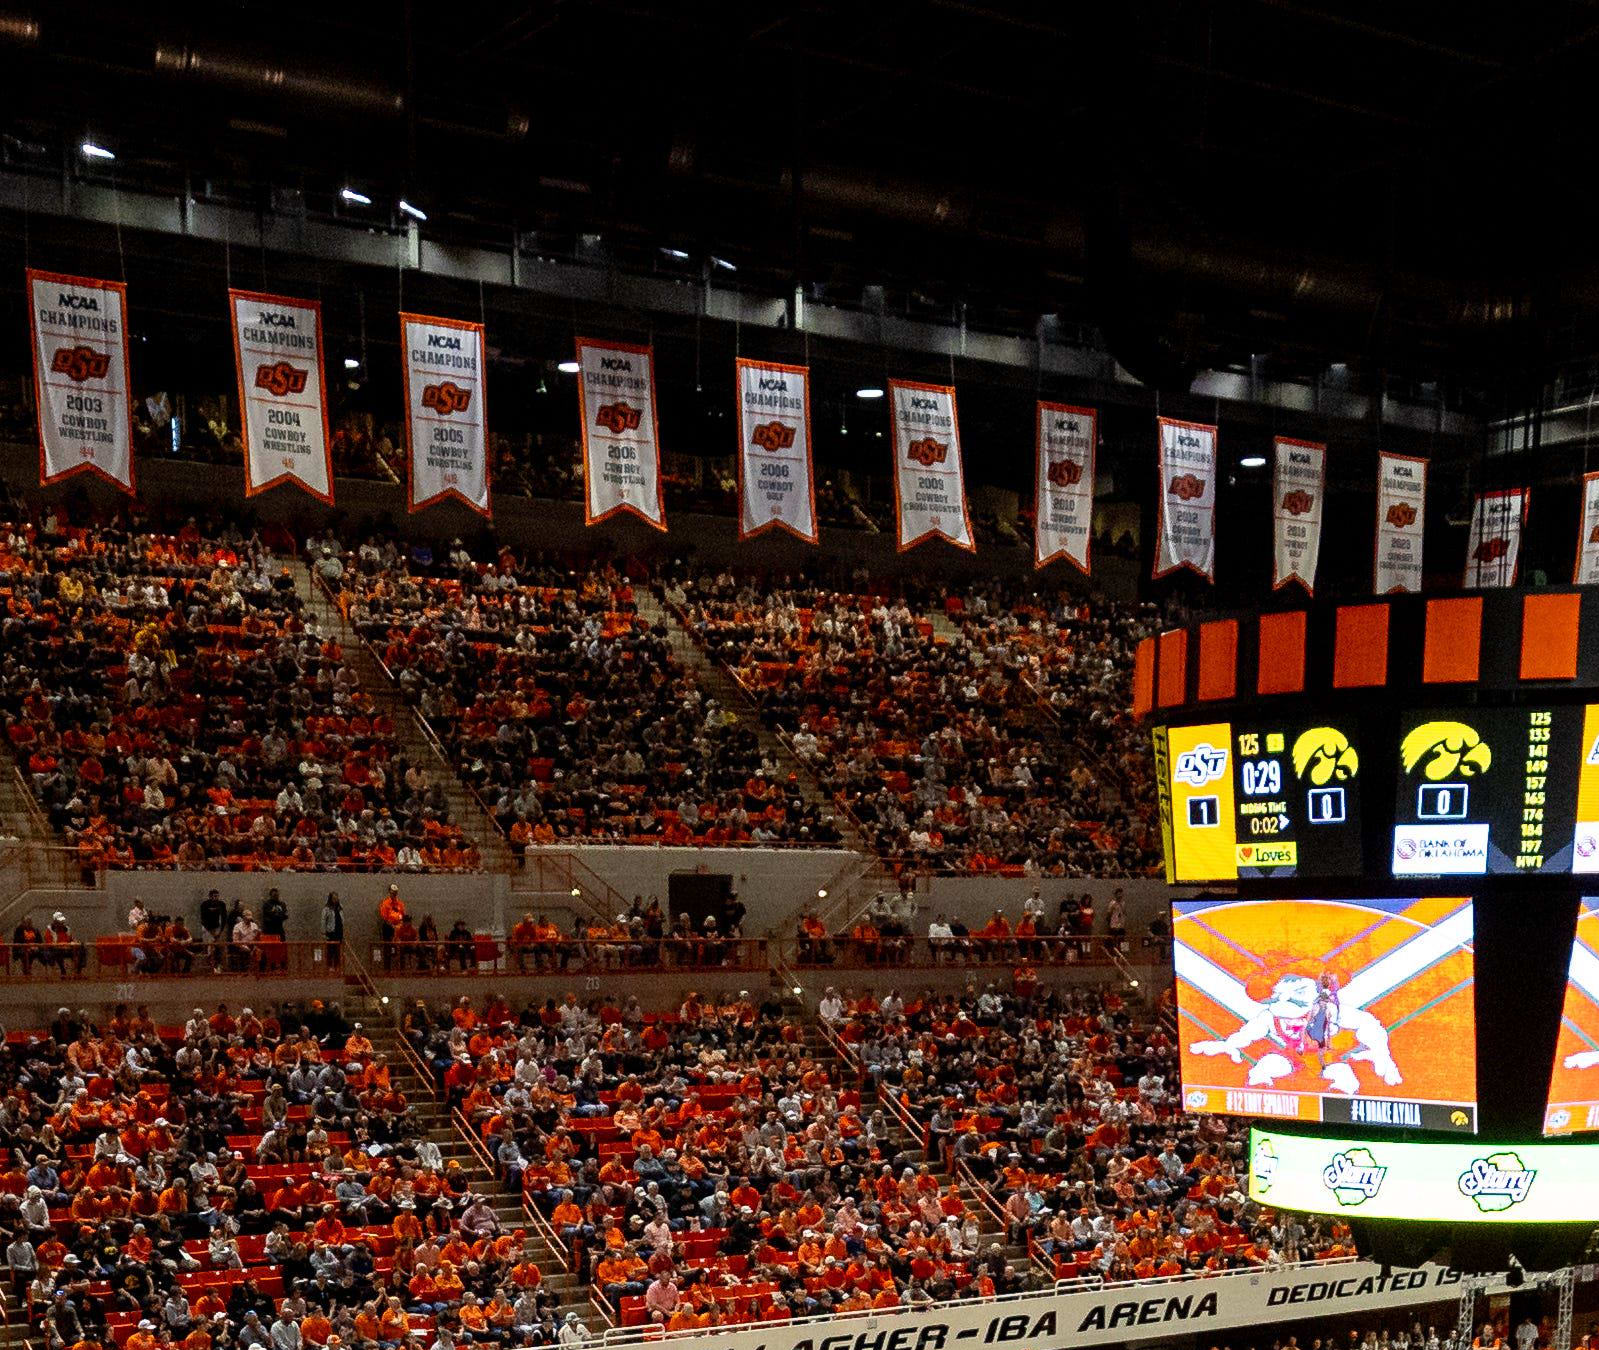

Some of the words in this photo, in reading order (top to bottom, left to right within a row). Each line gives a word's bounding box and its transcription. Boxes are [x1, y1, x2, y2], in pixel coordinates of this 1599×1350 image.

[58, 293, 99, 311] NCAA
[39, 309, 118, 334] CHAMPIONS
[258, 312, 295, 328] NCAA
[243, 327, 315, 350] CHAMPIONS
[428, 334, 461, 350] NCAA
[51, 345, 112, 383] OSU
[412, 350, 476, 370] CHAMPIONS
[601, 357, 632, 373] NCAA
[255, 361, 309, 397] OSU
[586, 372, 647, 391] CHAMPIONS
[758, 378, 788, 393] NCAA
[66, 395, 102, 412] 2003
[421, 381, 472, 416] OSU
[745, 392, 803, 410] CHAMPIONS
[911, 397, 939, 411] NCAA
[62, 414, 107, 431] COWBOY
[268, 409, 301, 426] 2004
[900, 409, 951, 427] CHAMPIONS
[59, 427, 114, 443] WRESTLING
[264, 427, 306, 443] COWBOY
[433, 427, 464, 444] 2005
[262, 440, 312, 455] WRESTLING
[429, 444, 467, 459] COWBOY
[608, 444, 636, 459] 2006
[1530, 712, 1551, 726] 125
[1529, 728, 1550, 741] 133
[1238, 733, 1259, 755] 125
[1529, 744, 1549, 758] 141
[1173, 743, 1229, 787] OSU
[1526, 760, 1548, 774] 149
[1242, 760, 1281, 795] 0:29
[1526, 776, 1547, 790] 157
[1321, 794, 1332, 819] 0
[1437, 789, 1451, 815] 0
[1525, 792, 1546, 806] 165
[1523, 808, 1544, 821] 174
[1251, 817, 1279, 834] 0:02
[1521, 823, 1543, 837] 184
[1419, 839, 1450, 848] BANK
[1521, 839, 1542, 853] 197
[1419, 849, 1484, 858] OKLAHOMA
[1515, 855, 1544, 868] HWT
[1322, 1152, 1388, 1198] Starry
[1458, 1158, 1538, 1203] Starry
[1266, 1270, 1427, 1307] DEDICATED
[1077, 1291, 1218, 1332] ARENA
